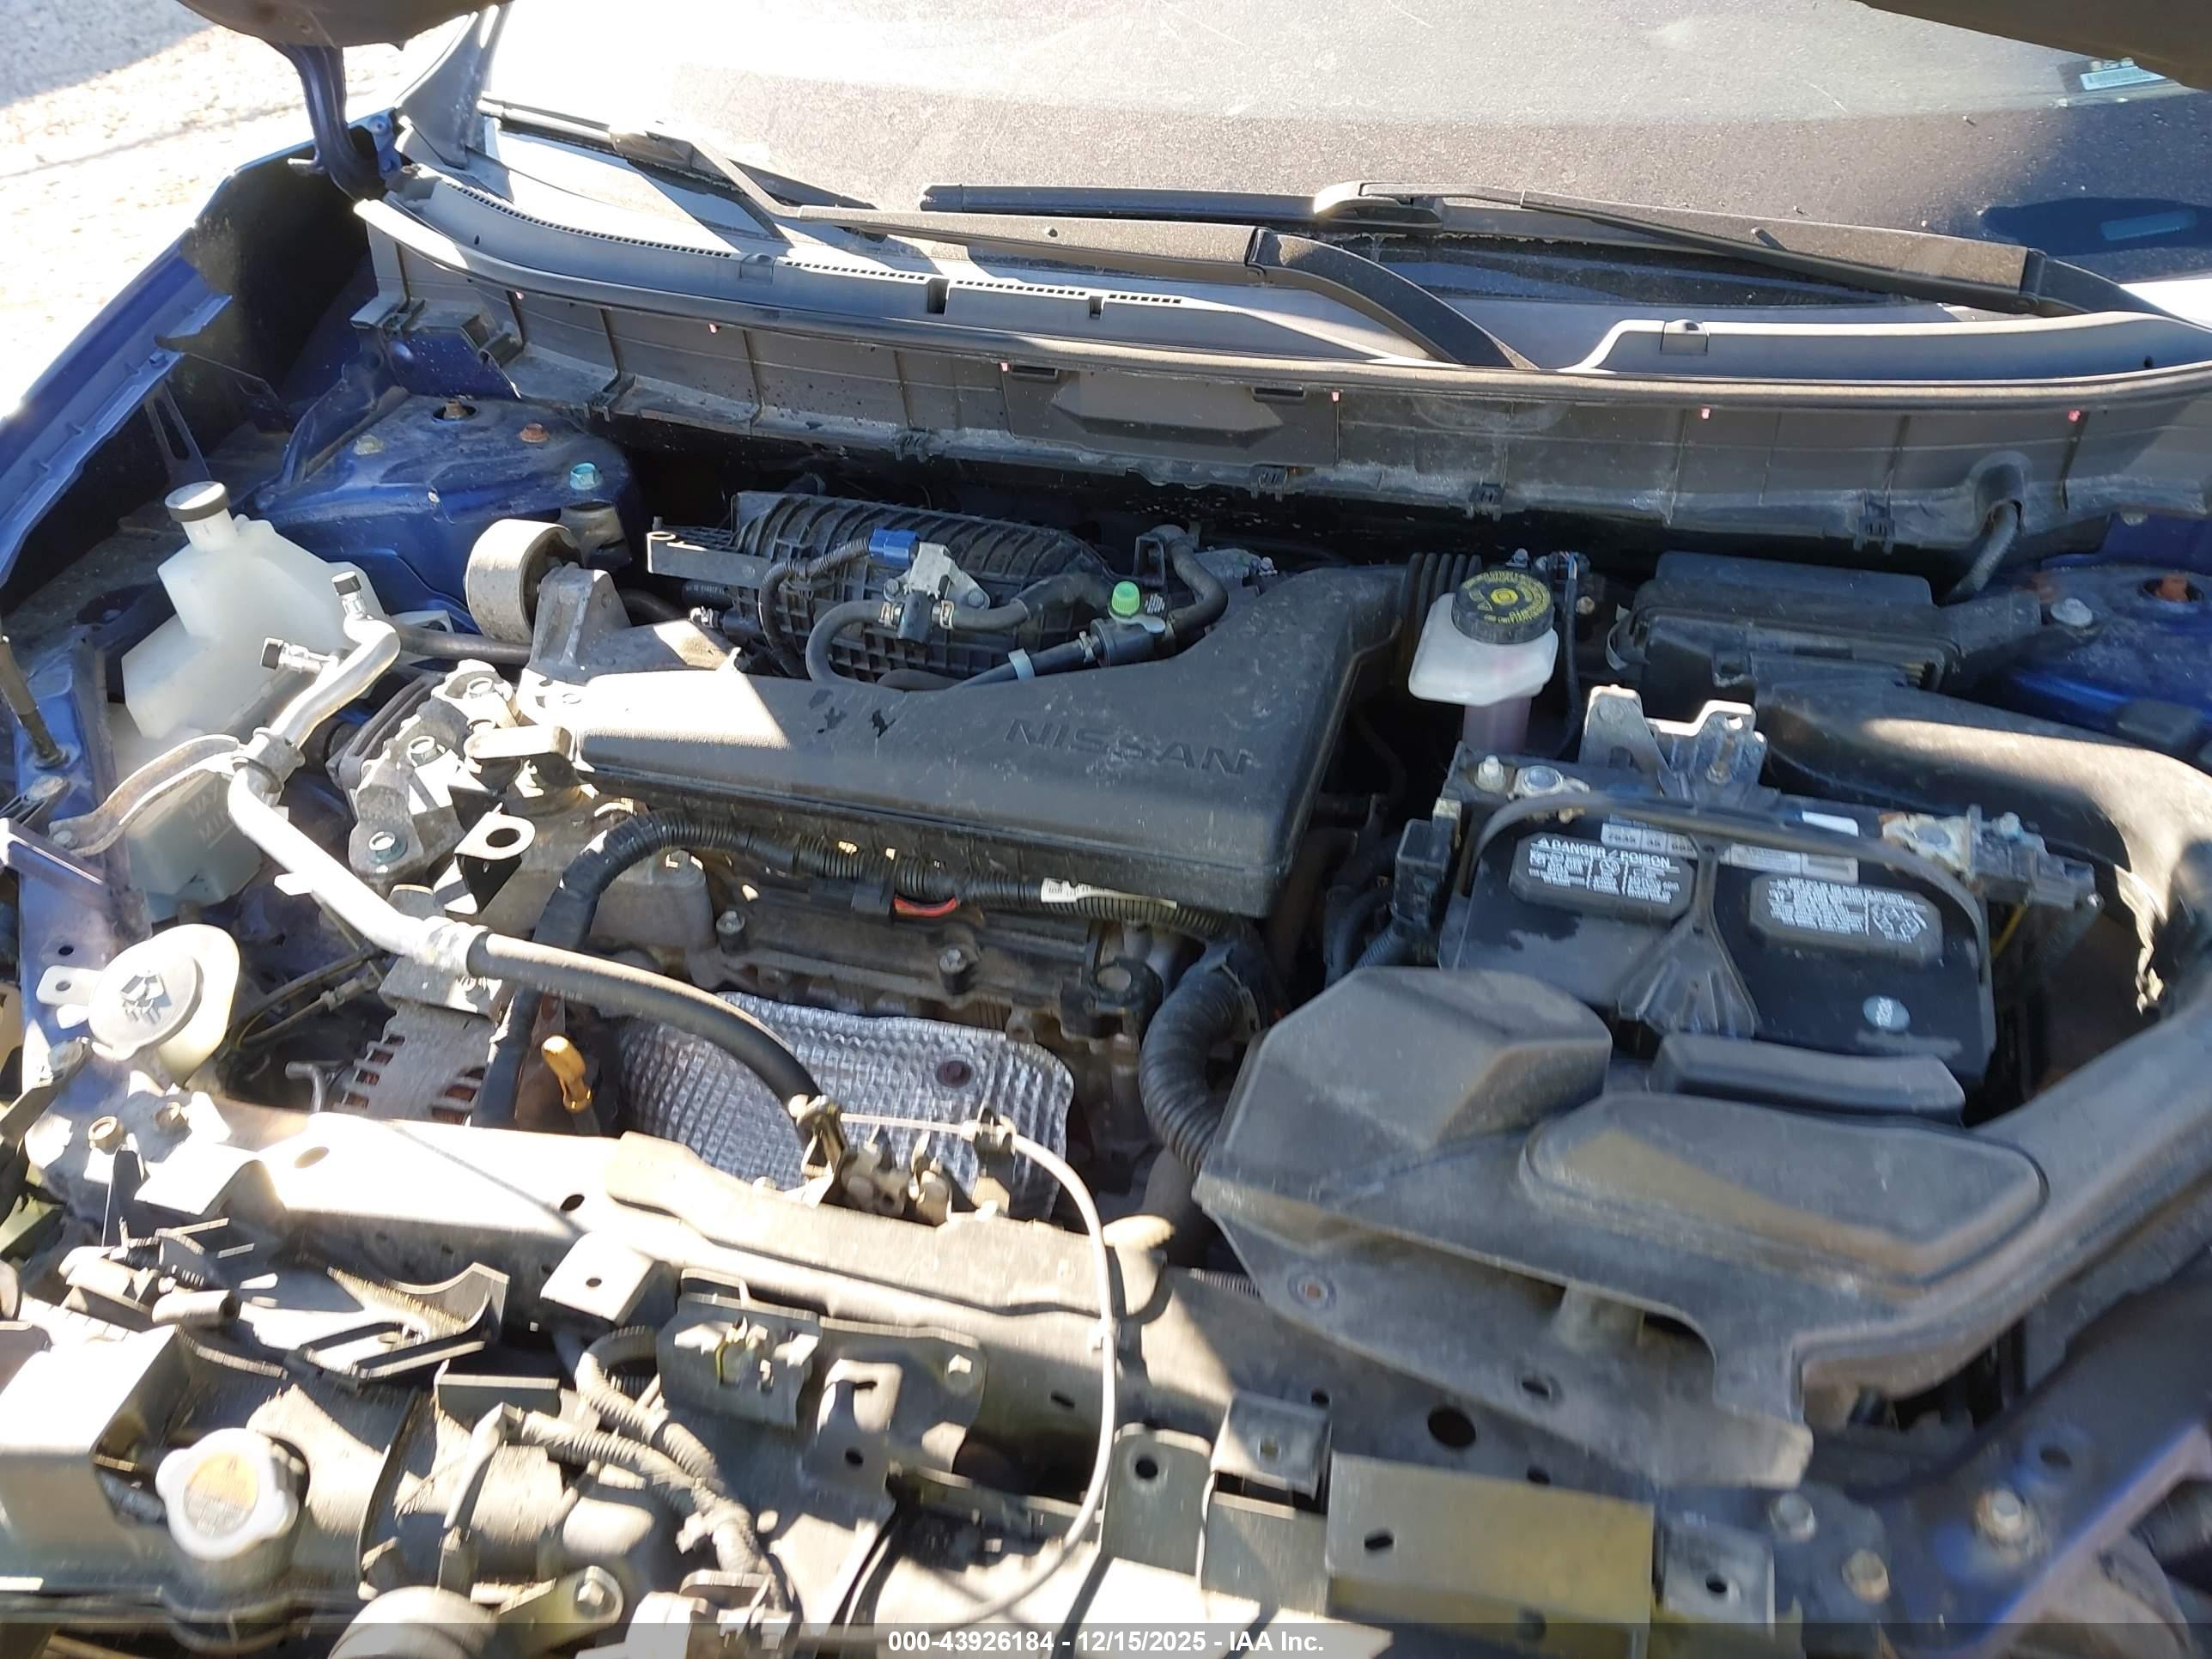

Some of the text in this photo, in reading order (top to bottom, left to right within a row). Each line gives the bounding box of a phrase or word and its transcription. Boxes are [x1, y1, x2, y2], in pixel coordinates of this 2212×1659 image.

[1003, 718, 1253, 776] NISSAN
[1551, 838, 1671, 870] DANGER POISON
